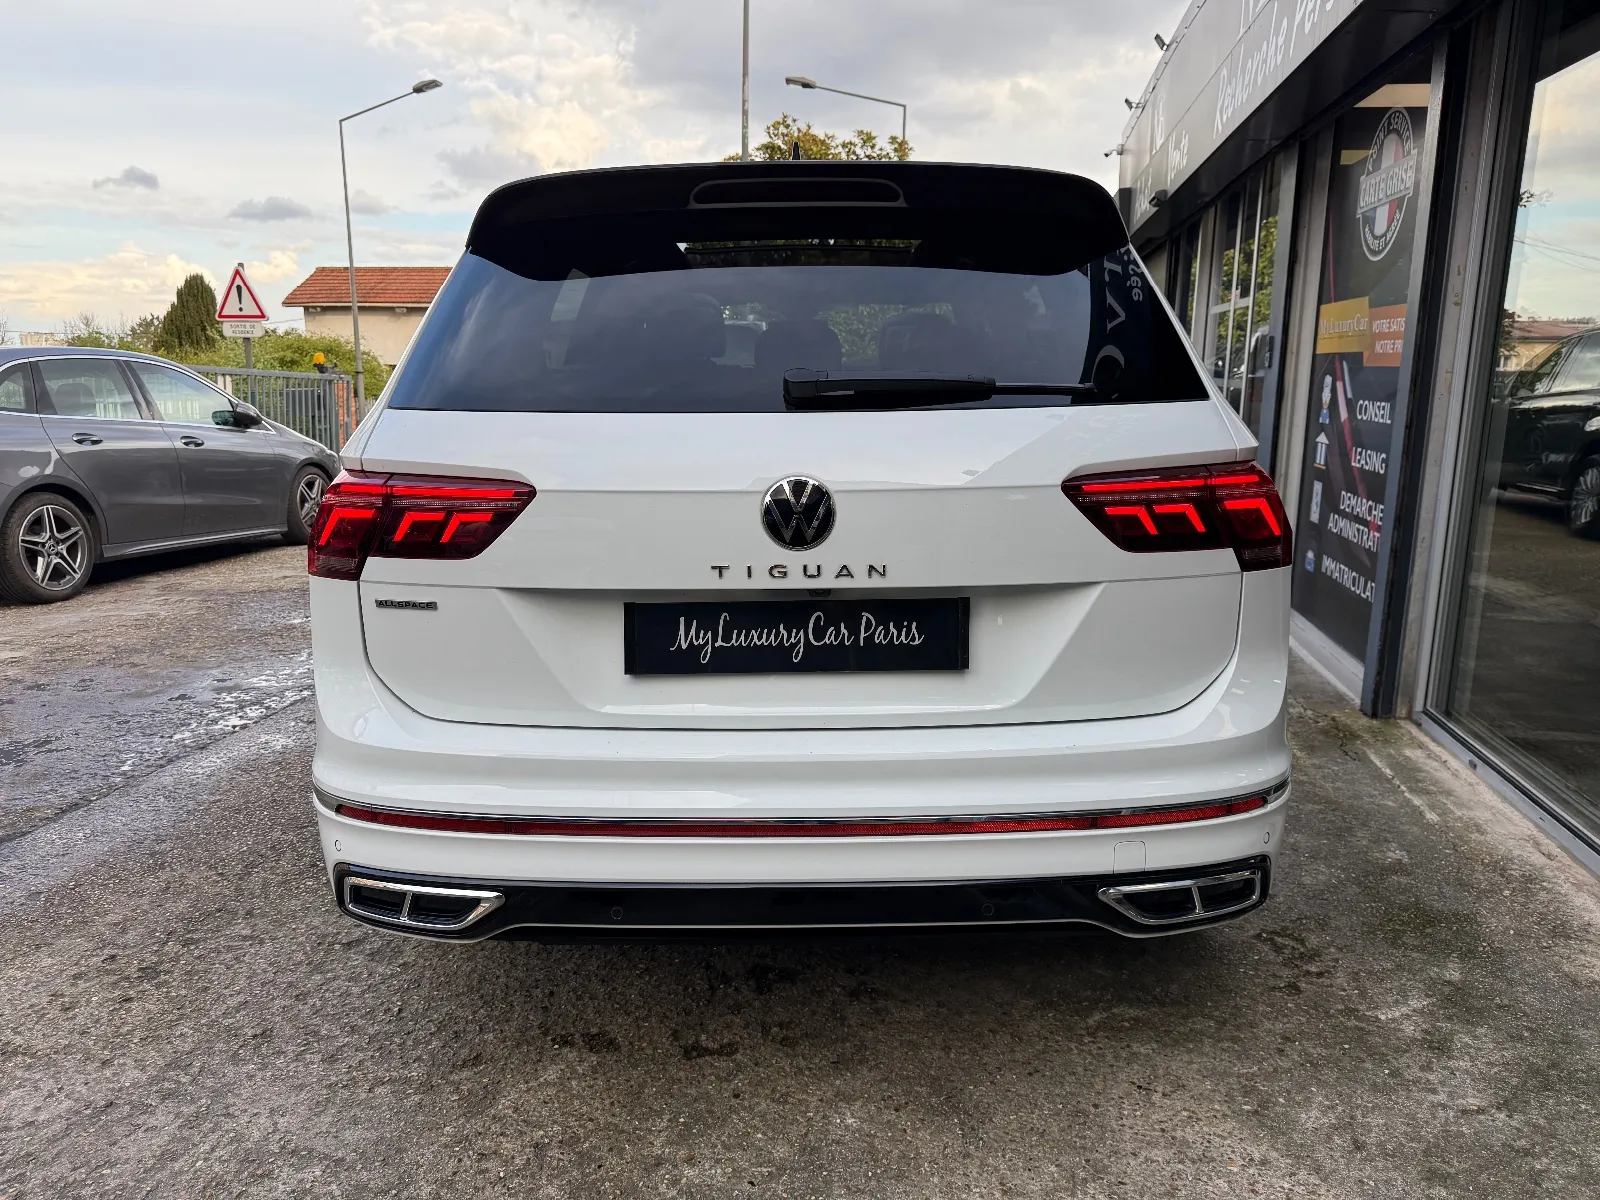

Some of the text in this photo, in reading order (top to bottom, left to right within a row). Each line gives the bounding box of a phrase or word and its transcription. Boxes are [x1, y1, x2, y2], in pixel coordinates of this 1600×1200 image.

[1213, 1, 1288, 139] Recherche
[1390, 112, 1412, 157] SERVICE
[1359, 158, 1414, 208] CARTE GRISE
[1372, 319, 1390, 333] VOTRE
[1375, 340, 1393, 354] NOTRE
[1356, 399, 1392, 424] CONSEIL
[1351, 446, 1387, 474] LEASING
[1340, 490, 1385, 526] DEMARCHE
[711, 564, 888, 579] TIGUAN
[377, 600, 435, 609] ALLSPACE
[859, 612, 925, 647] Paris
